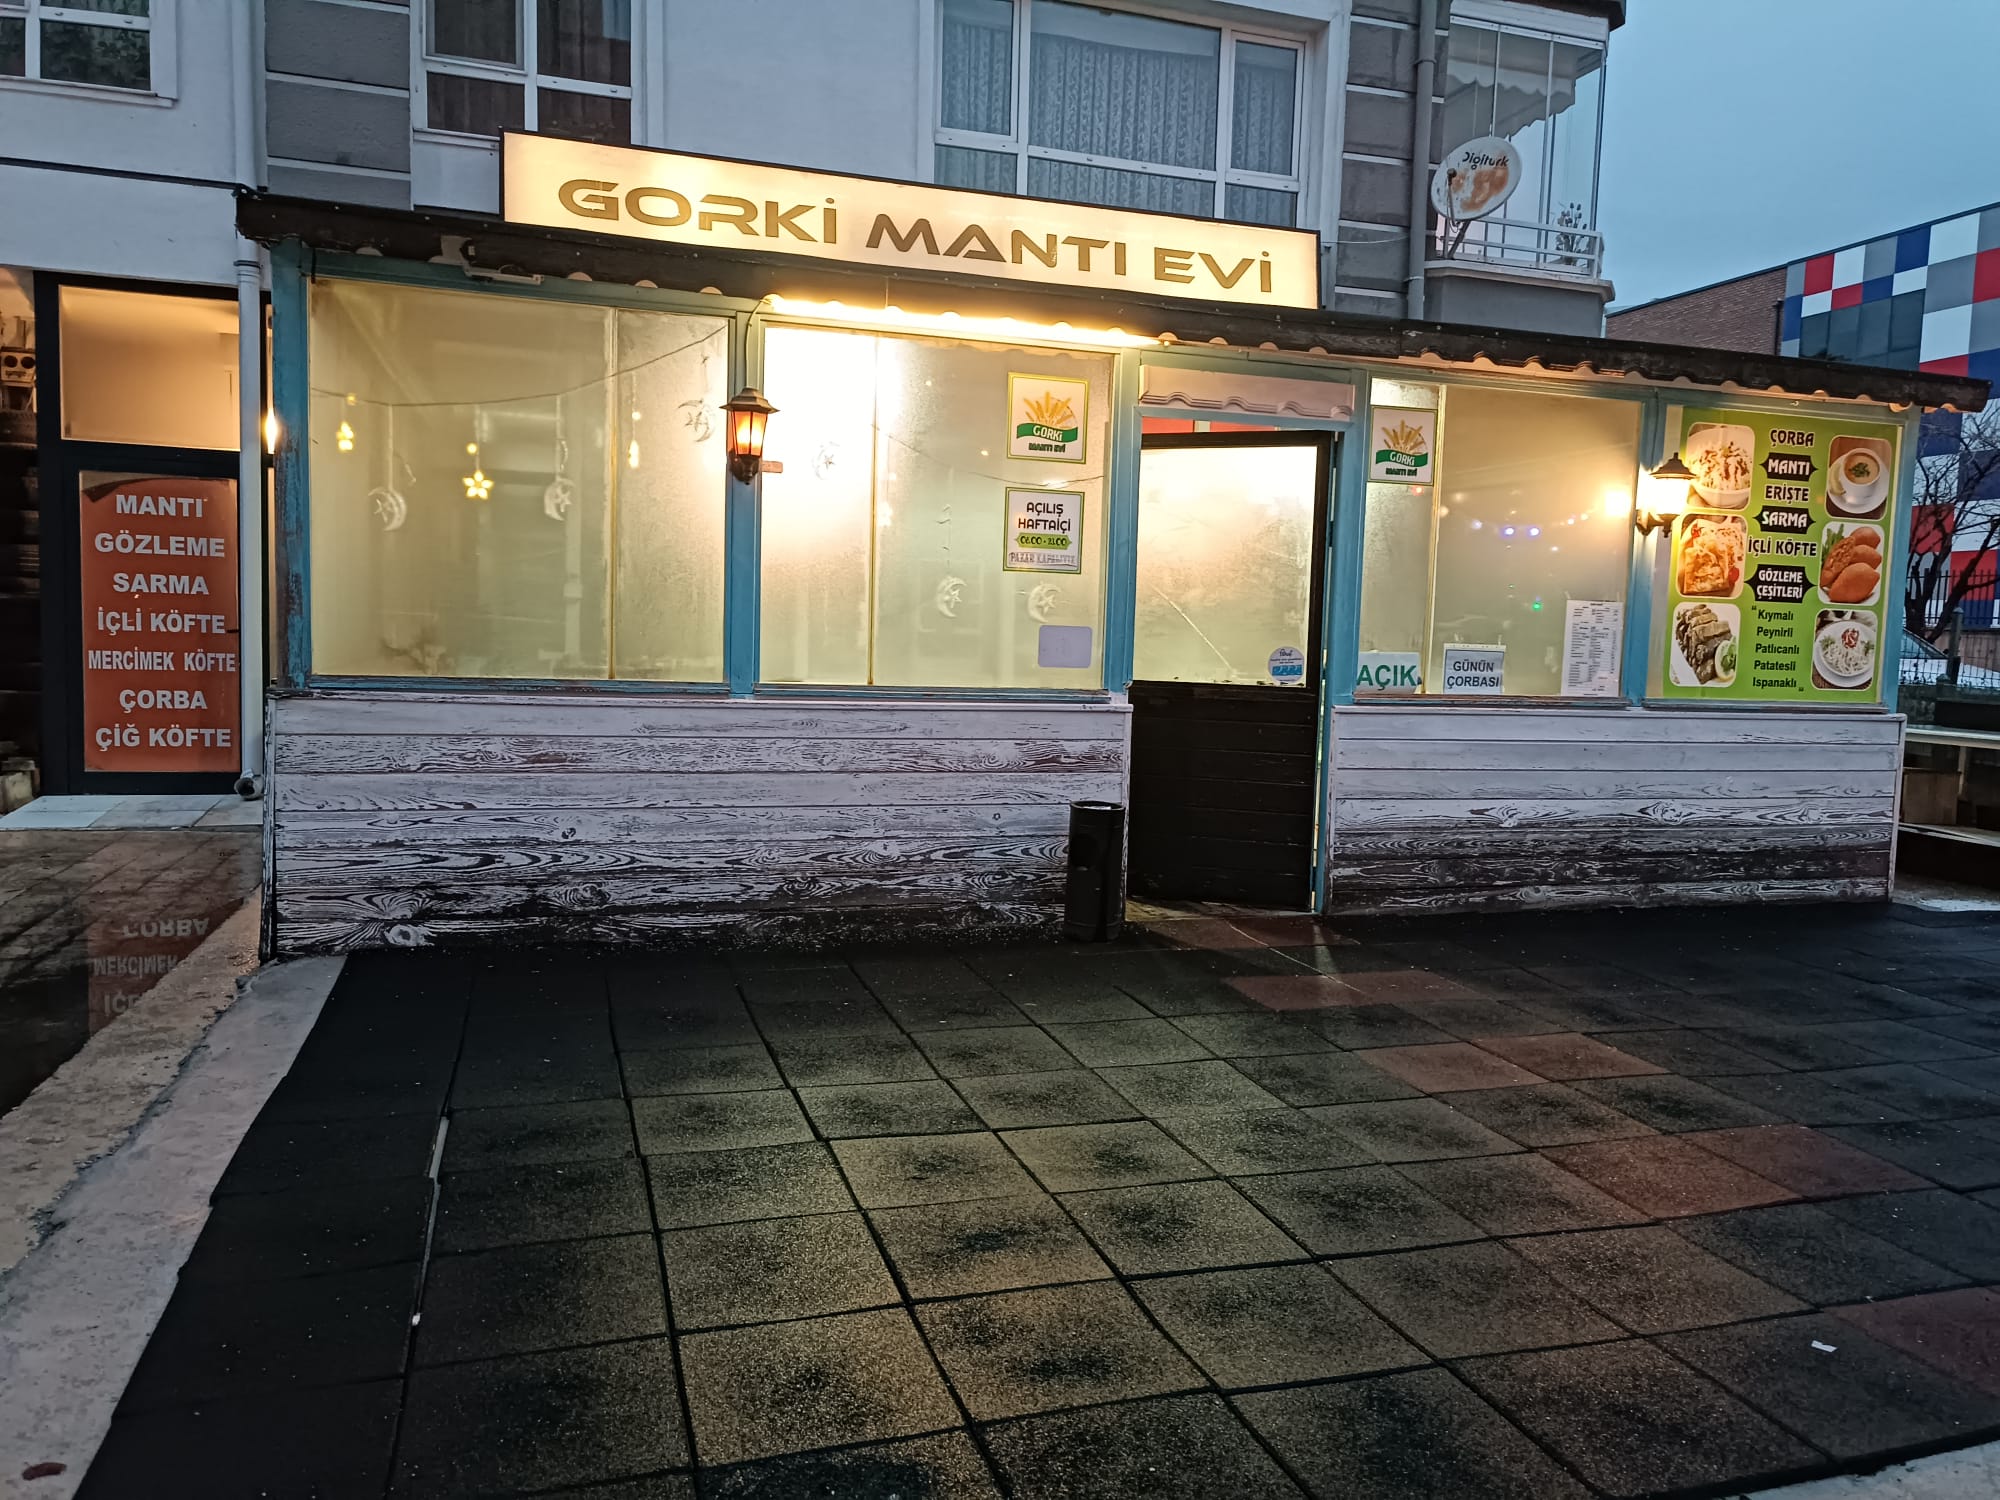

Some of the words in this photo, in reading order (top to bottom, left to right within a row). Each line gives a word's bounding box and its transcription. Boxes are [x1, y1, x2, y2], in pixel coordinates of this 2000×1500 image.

[1462, 152, 1509, 170] Digiturk
[558, 178, 838, 244] GORKİ
[865, 212, 1127, 276] MANTI
[1154, 248, 1272, 293] EVİ
[1770, 429, 1814, 447] ÇORBA
[1768, 459, 1810, 476] MANTI
[1765, 483, 1809, 504] ERİŞTE
[116, 494, 203, 518] MANTI
[1026, 502, 1064, 518] AÇILIŞ
[1018, 518, 1071, 534] HAFTAİÇİ
[1761, 511, 1807, 528] SARMA
[94, 529, 225, 558] GÖZLEME
[1748, 536, 1771, 557] İÇLİ
[1776, 539, 1817, 556] KÖFTE
[113, 573, 209, 595] SARMA
[1758, 568, 1803, 583] GÖZLEME
[1756, 583, 1803, 600] ÇEŞİTLERİ
[97, 606, 142, 636] İÇLİ
[151, 609, 226, 634] KÖFTE
[1758, 609, 1794, 622] Kıymalı
[1756, 626, 1793, 639] Peynirli
[1755, 643, 1800, 655] Patlıcanlı
[88, 646, 174, 672] MERCİMEK
[184, 649, 236, 673] KÖFTE
[1453, 659, 1494, 673] GÜNÜN
[1754, 660, 1796, 671] Patatesli
[1356, 664, 1417, 691] AÇIK
[1446, 675, 1500, 689] ÇORBASI
[1752, 677, 1797, 689] Ispanaklı
[119, 689, 208, 714] ÇORBA
[95, 723, 140, 752] ÇİĞ
[149, 725, 232, 748] KÖFTE
